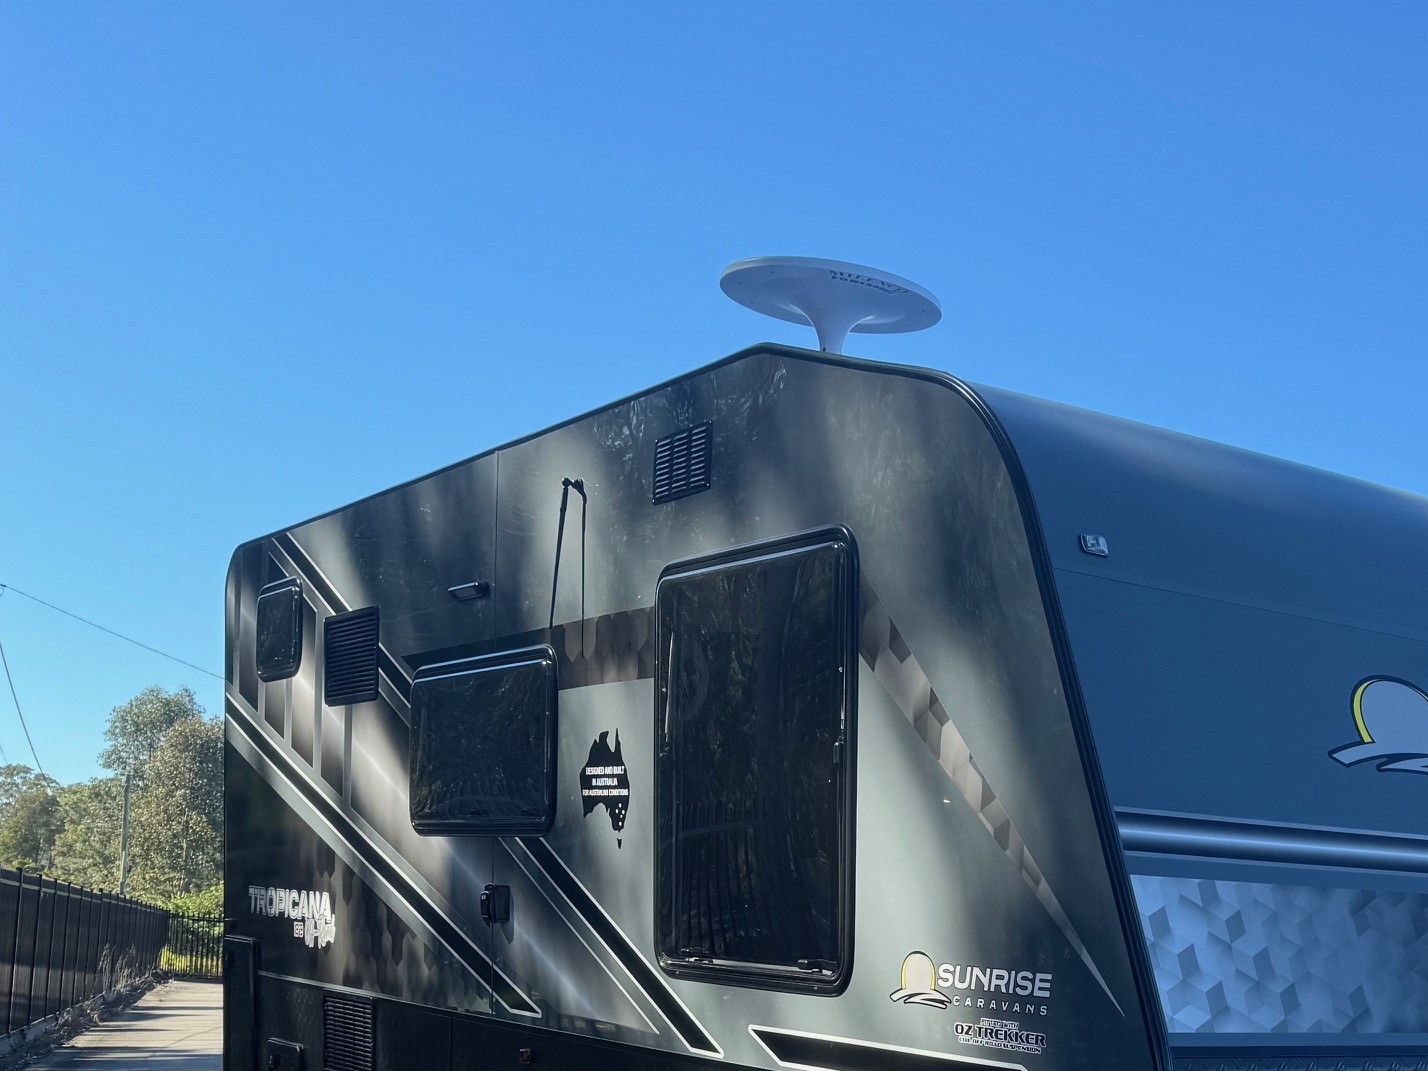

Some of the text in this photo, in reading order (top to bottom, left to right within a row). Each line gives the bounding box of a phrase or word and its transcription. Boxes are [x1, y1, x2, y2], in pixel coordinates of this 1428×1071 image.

[248, 885, 333, 923] TROPICANA
[937, 963, 1052, 998] SUNRISE
[952, 995, 1049, 1016] CARAVANS
[954, 1022, 1047, 1047] OZ TREKKER
